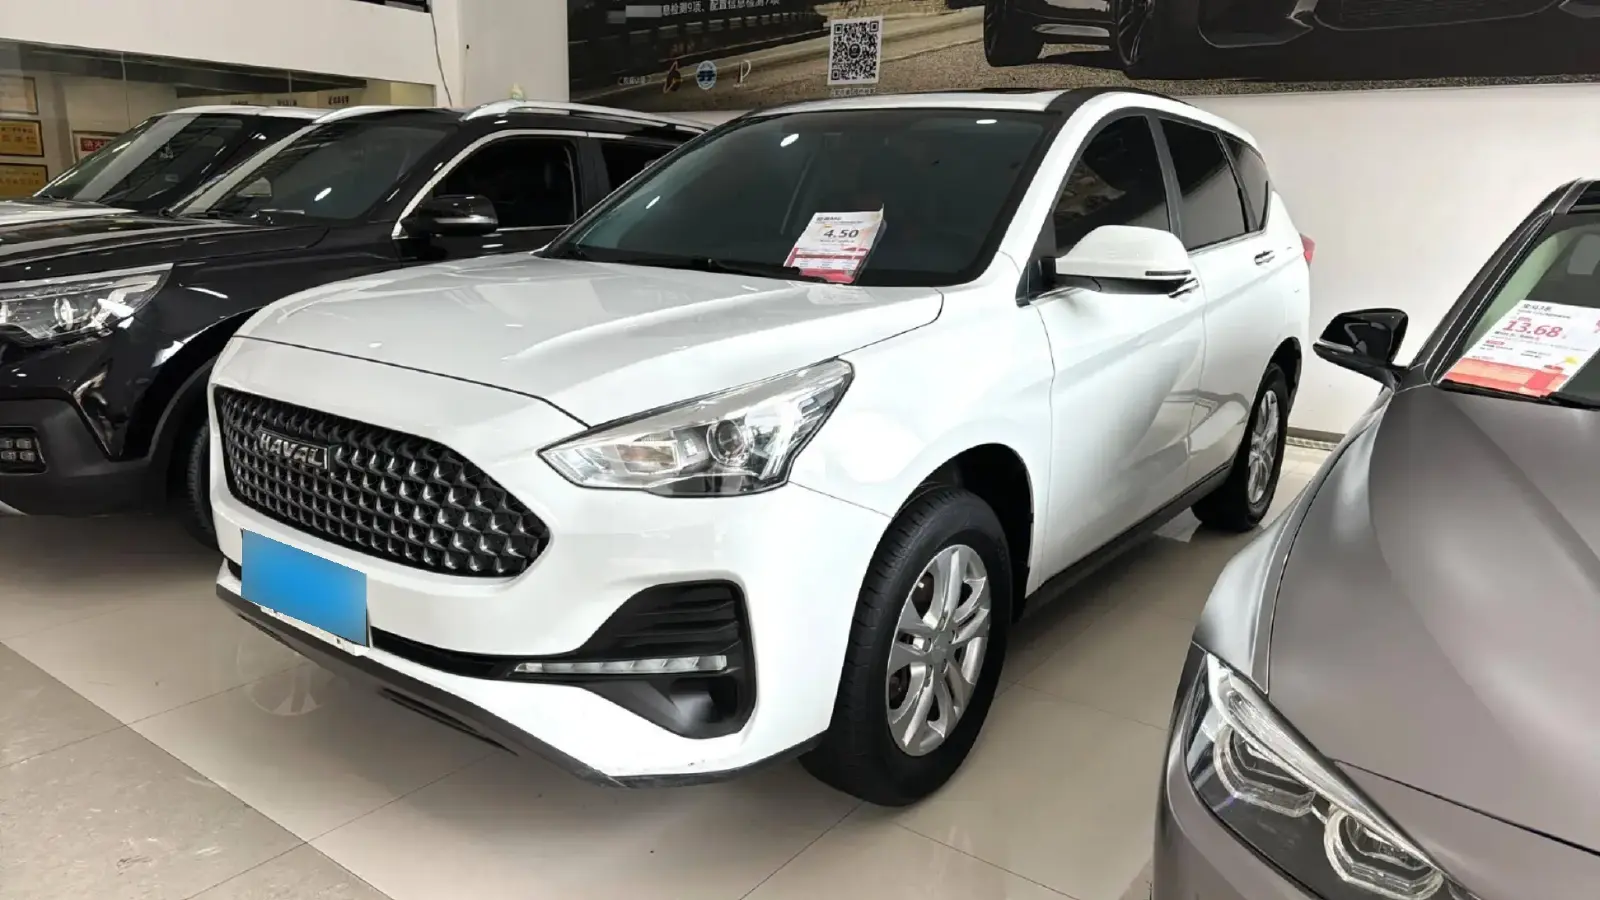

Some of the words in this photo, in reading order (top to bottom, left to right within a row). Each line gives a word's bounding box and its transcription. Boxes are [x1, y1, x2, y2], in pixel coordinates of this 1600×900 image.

[824, 229, 859, 239] 4.50
[1502, 319, 1563, 338] 13.68
[260, 432, 322, 467] HAVAL
